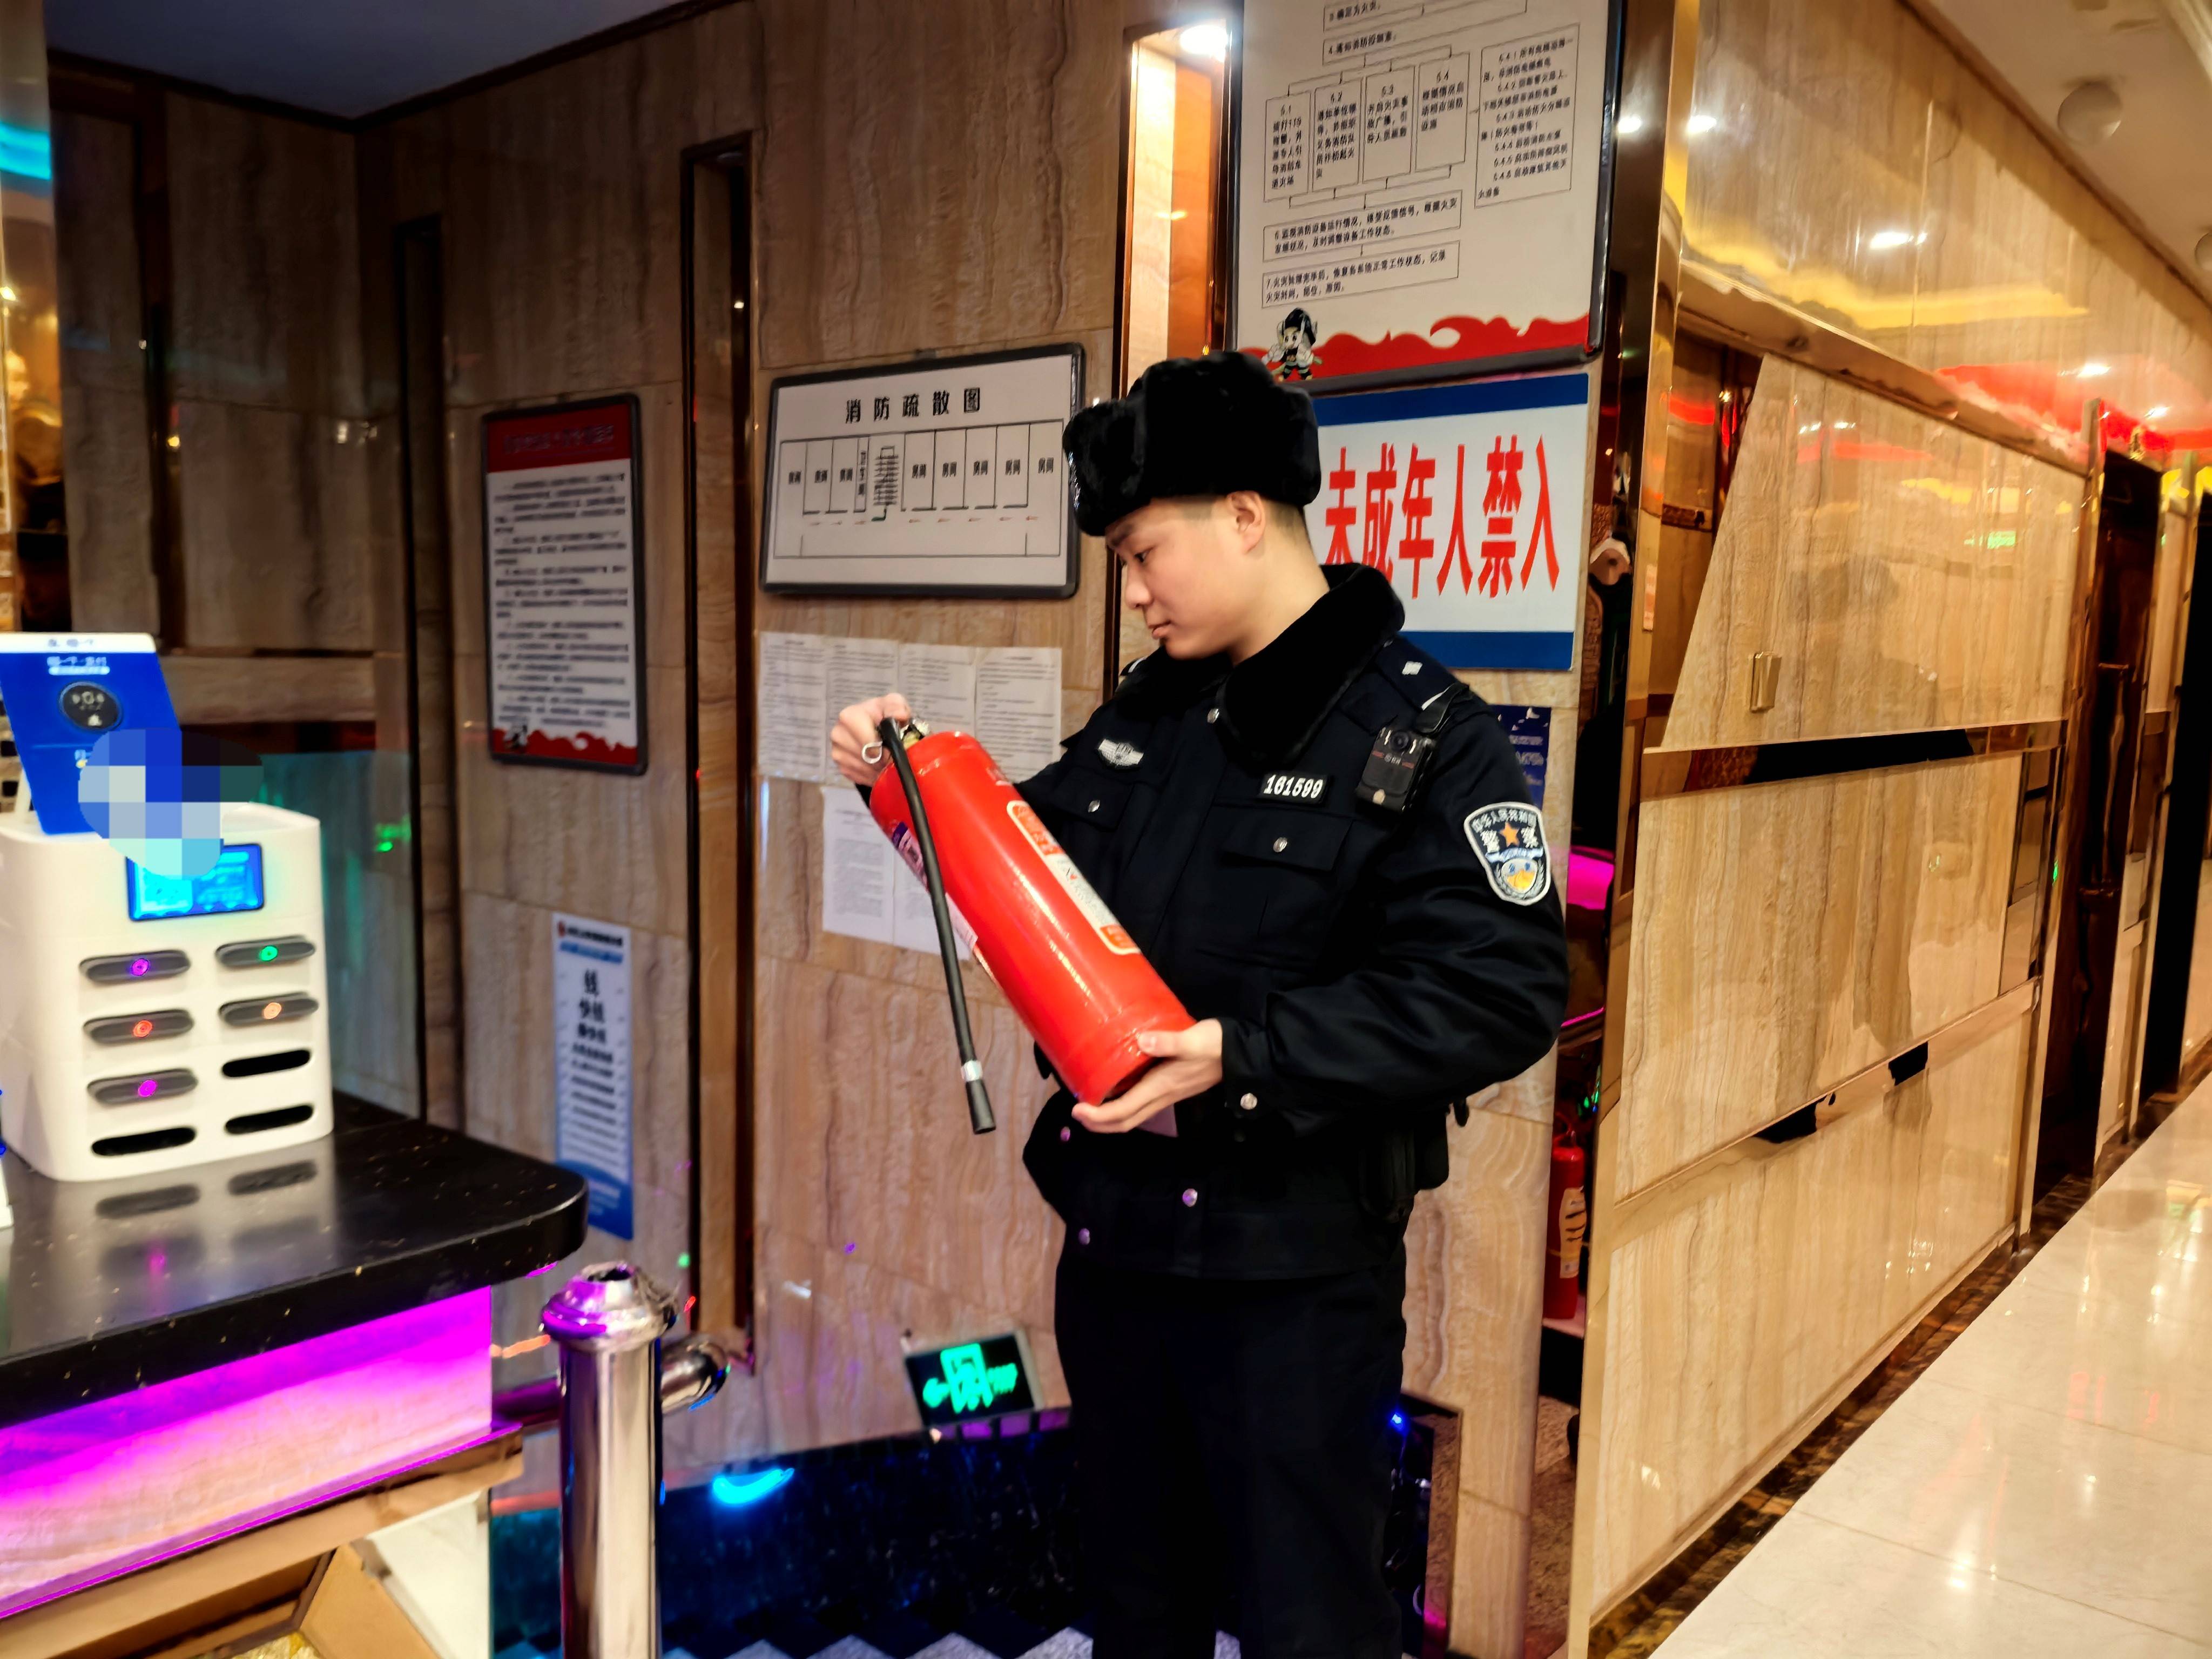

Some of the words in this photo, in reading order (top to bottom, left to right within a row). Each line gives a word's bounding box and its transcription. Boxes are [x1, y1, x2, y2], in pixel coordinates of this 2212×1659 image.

[846, 387, 980, 423] 消防疏散图
[1325, 434, 1560, 599] 未成年人禁入
